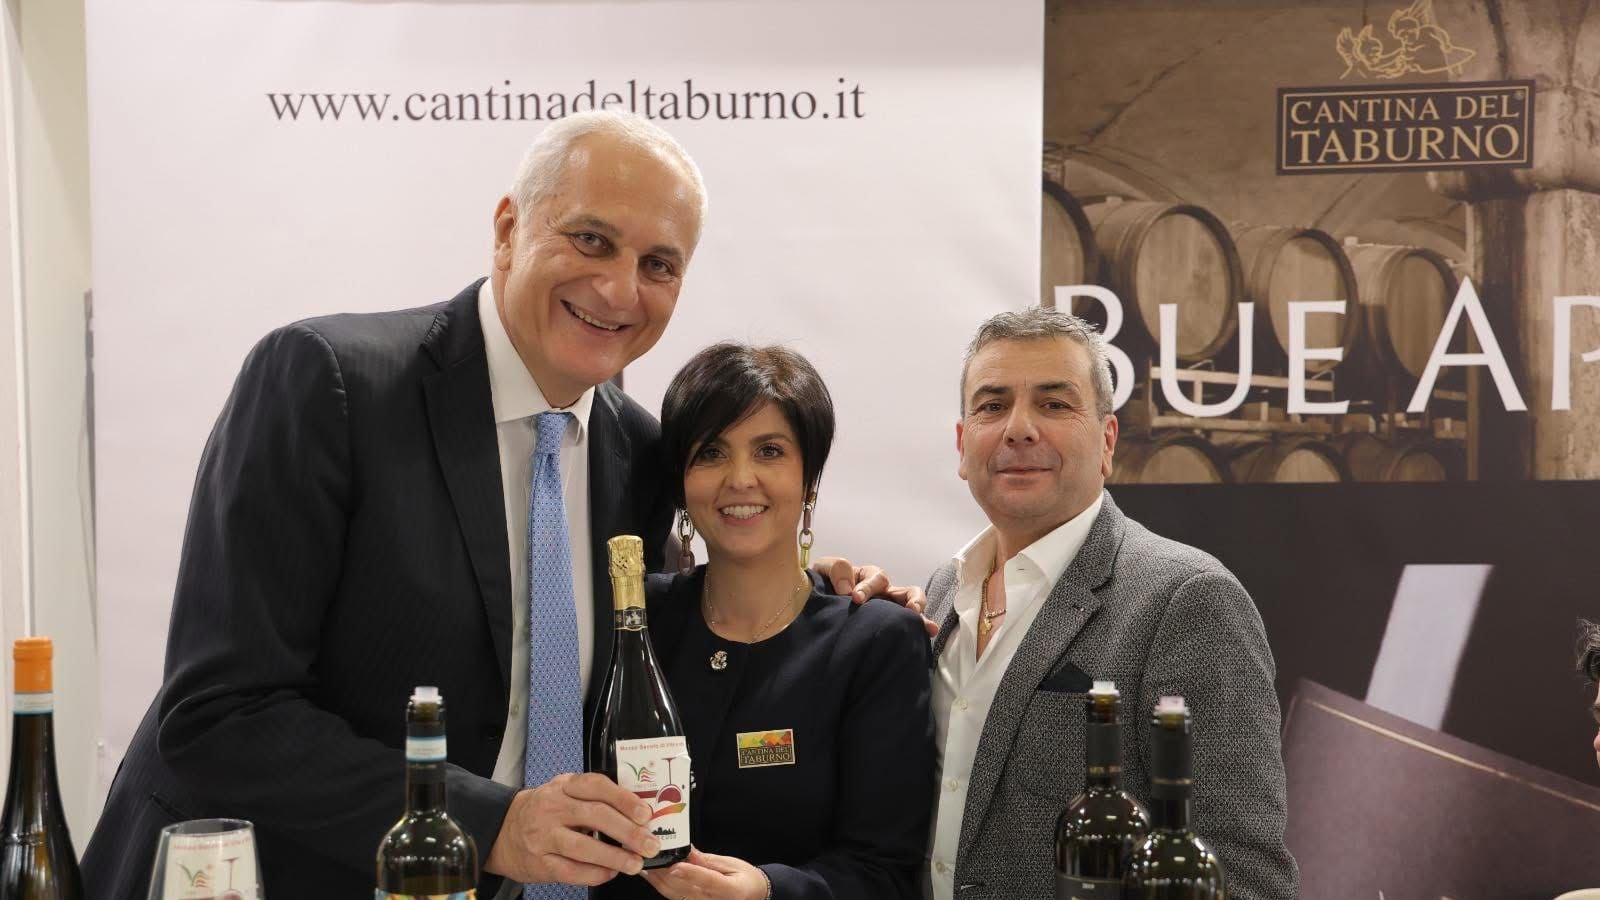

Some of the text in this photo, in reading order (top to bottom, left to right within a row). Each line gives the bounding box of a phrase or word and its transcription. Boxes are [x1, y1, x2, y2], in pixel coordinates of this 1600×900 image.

[266, 78, 866, 121] www.cantinadeltaburno.it
[1291, 95, 1519, 124] CANTINA DEL
[1291, 124, 1520, 164] TABURNO
[1054, 284, 1349, 417] BUE
[742, 748, 773, 756] CANTINA
[743, 753, 790, 764] TABURNO
